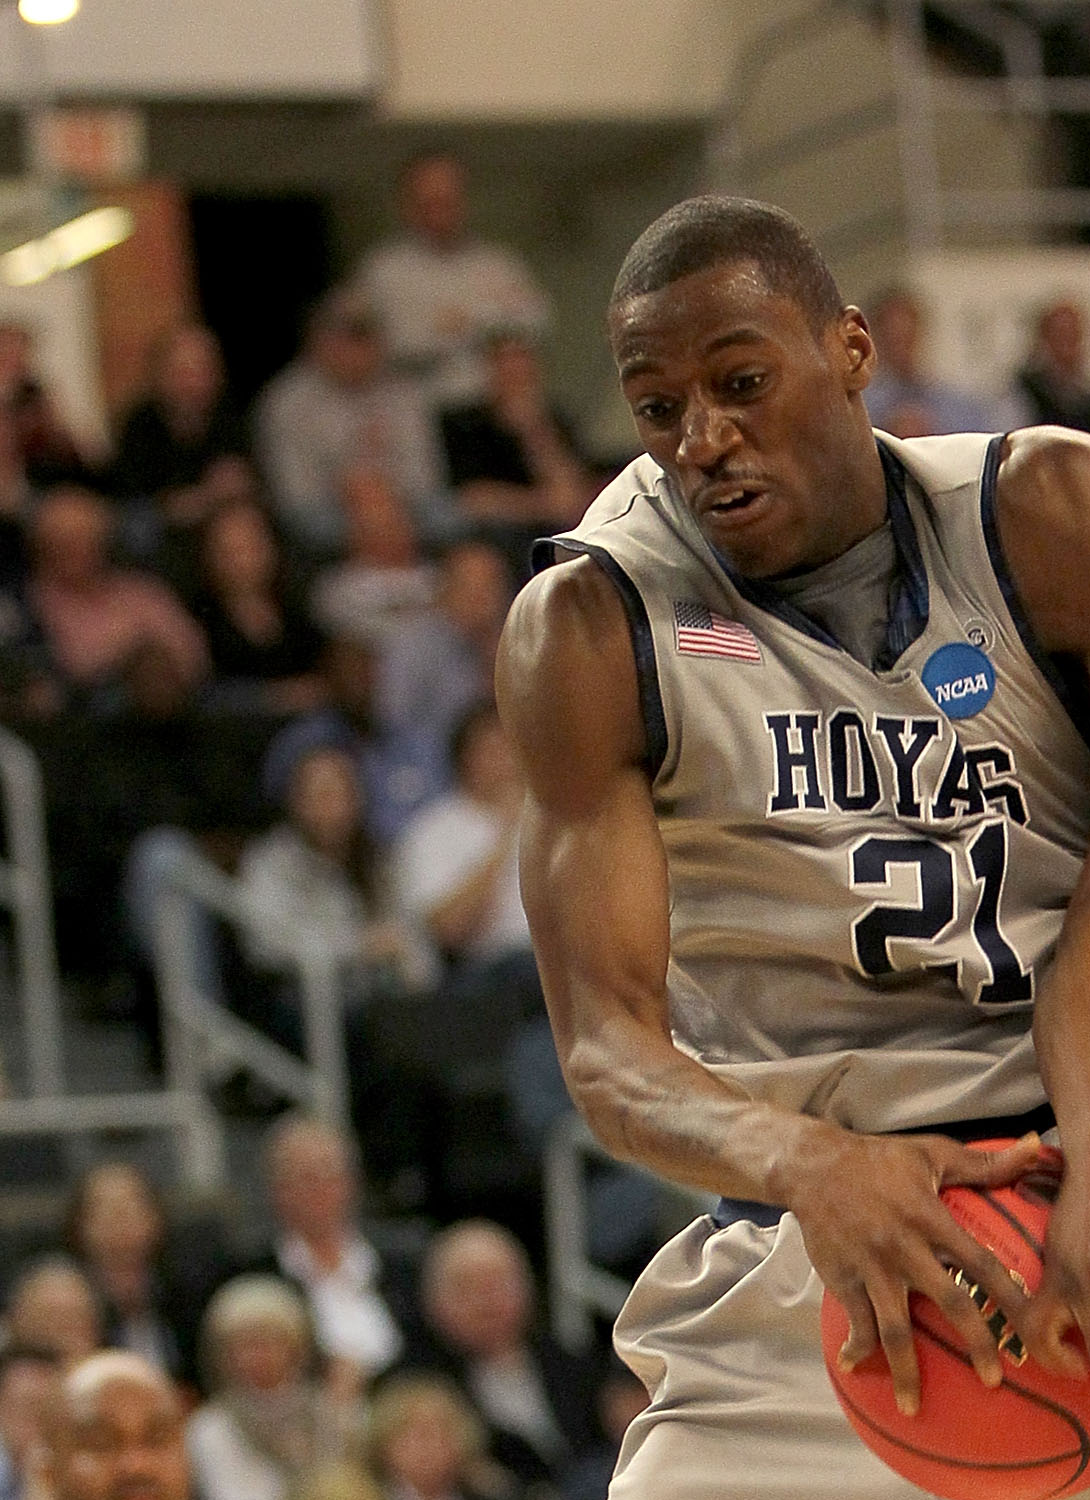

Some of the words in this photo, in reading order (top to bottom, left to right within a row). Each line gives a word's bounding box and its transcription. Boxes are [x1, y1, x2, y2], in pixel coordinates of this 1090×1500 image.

[935, 673, 989, 704] NCAA
[764, 708, 1030, 829] HOYAS
[850, 818, 1035, 1006] 21
